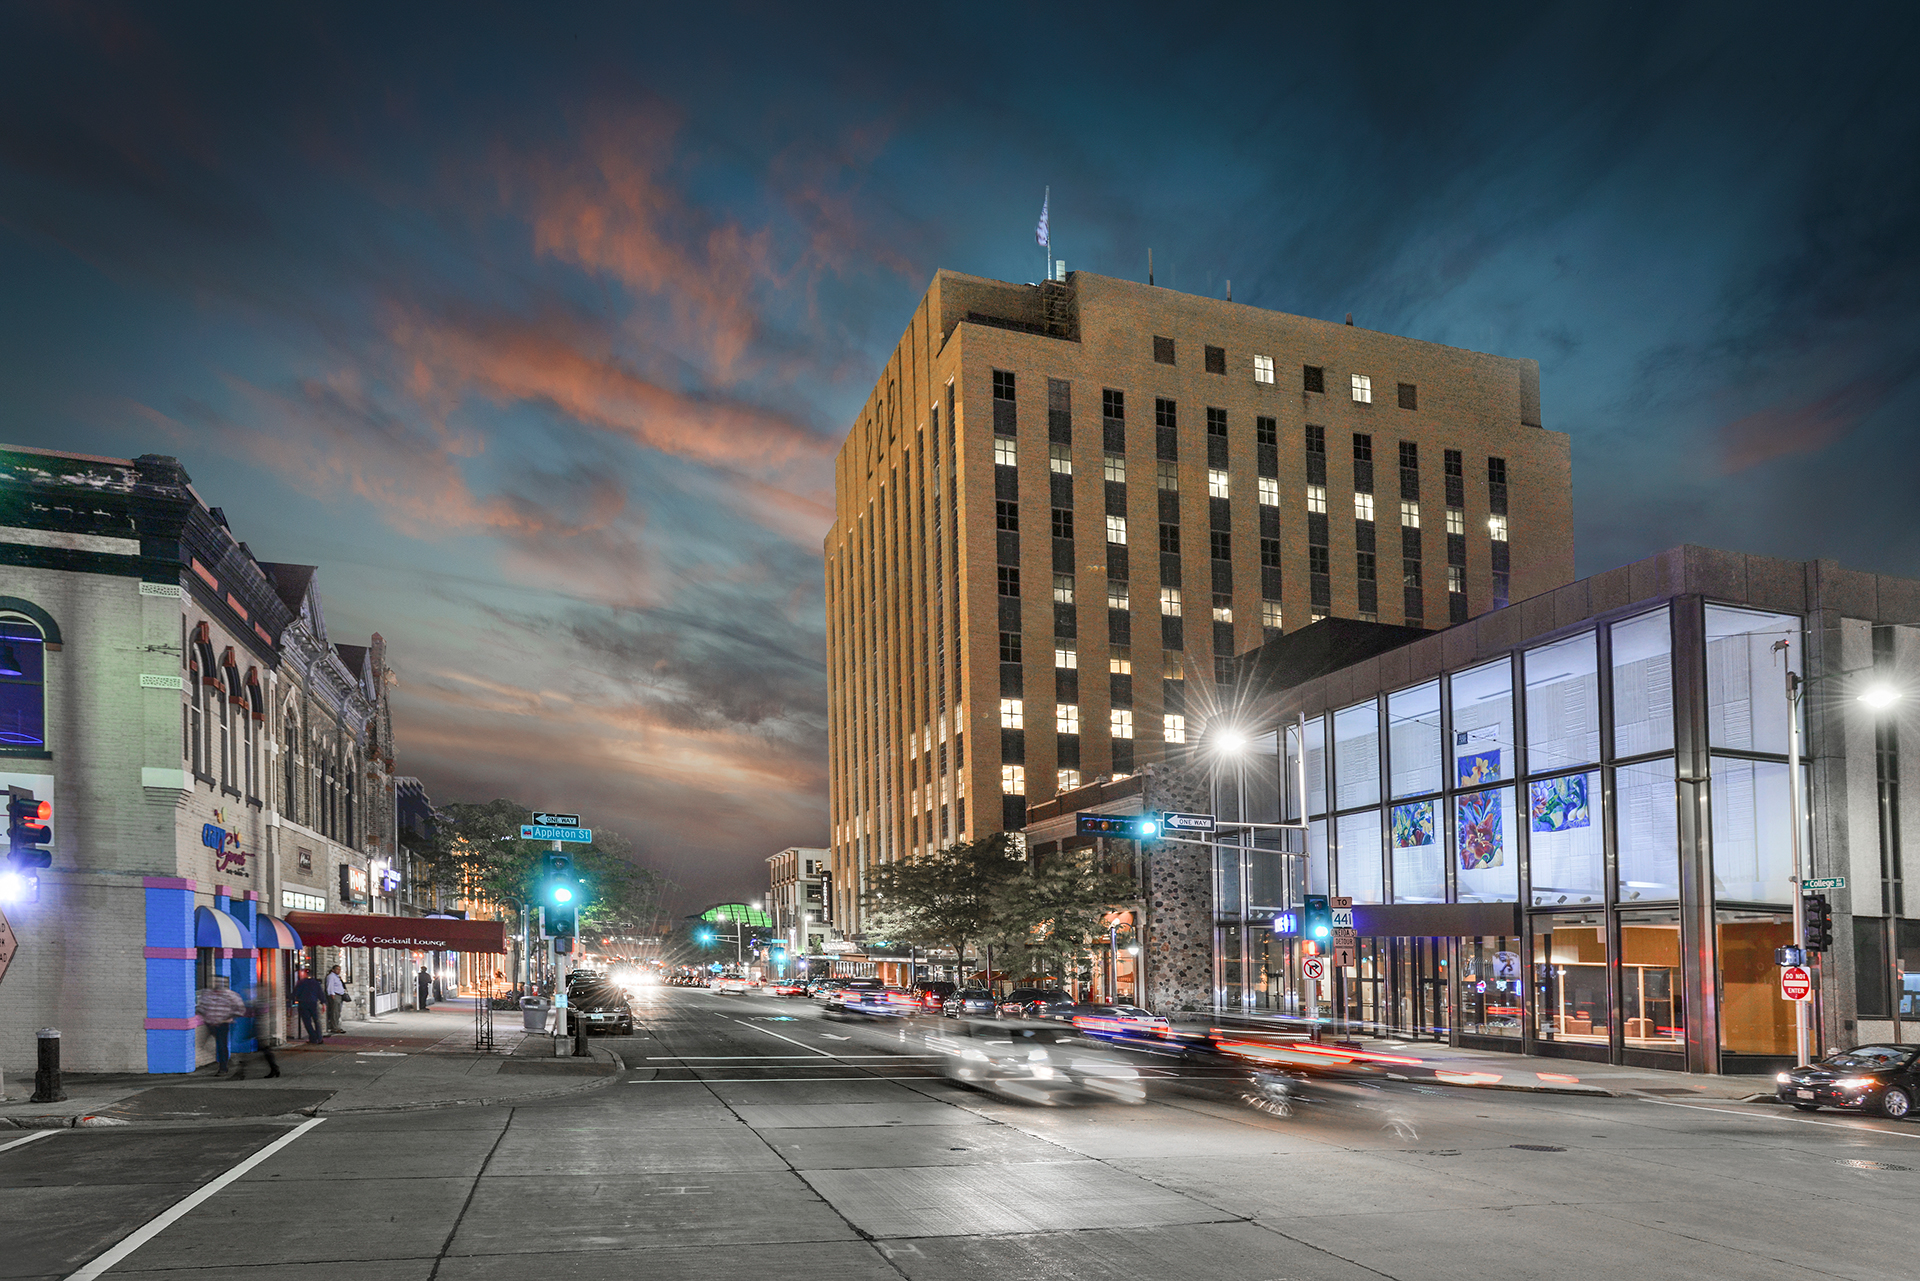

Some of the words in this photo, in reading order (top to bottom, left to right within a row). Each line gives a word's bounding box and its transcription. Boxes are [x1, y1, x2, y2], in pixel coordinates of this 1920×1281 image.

[865, 378, 896, 481] 222
[534, 827, 576, 839] Appleton
[578, 830, 589, 840] St
[1809, 879, 1835, 889] College
[1333, 913, 1353, 925] 441
[341, 934, 366, 944] Cleo's
[372, 936, 411, 945] Cocktail
